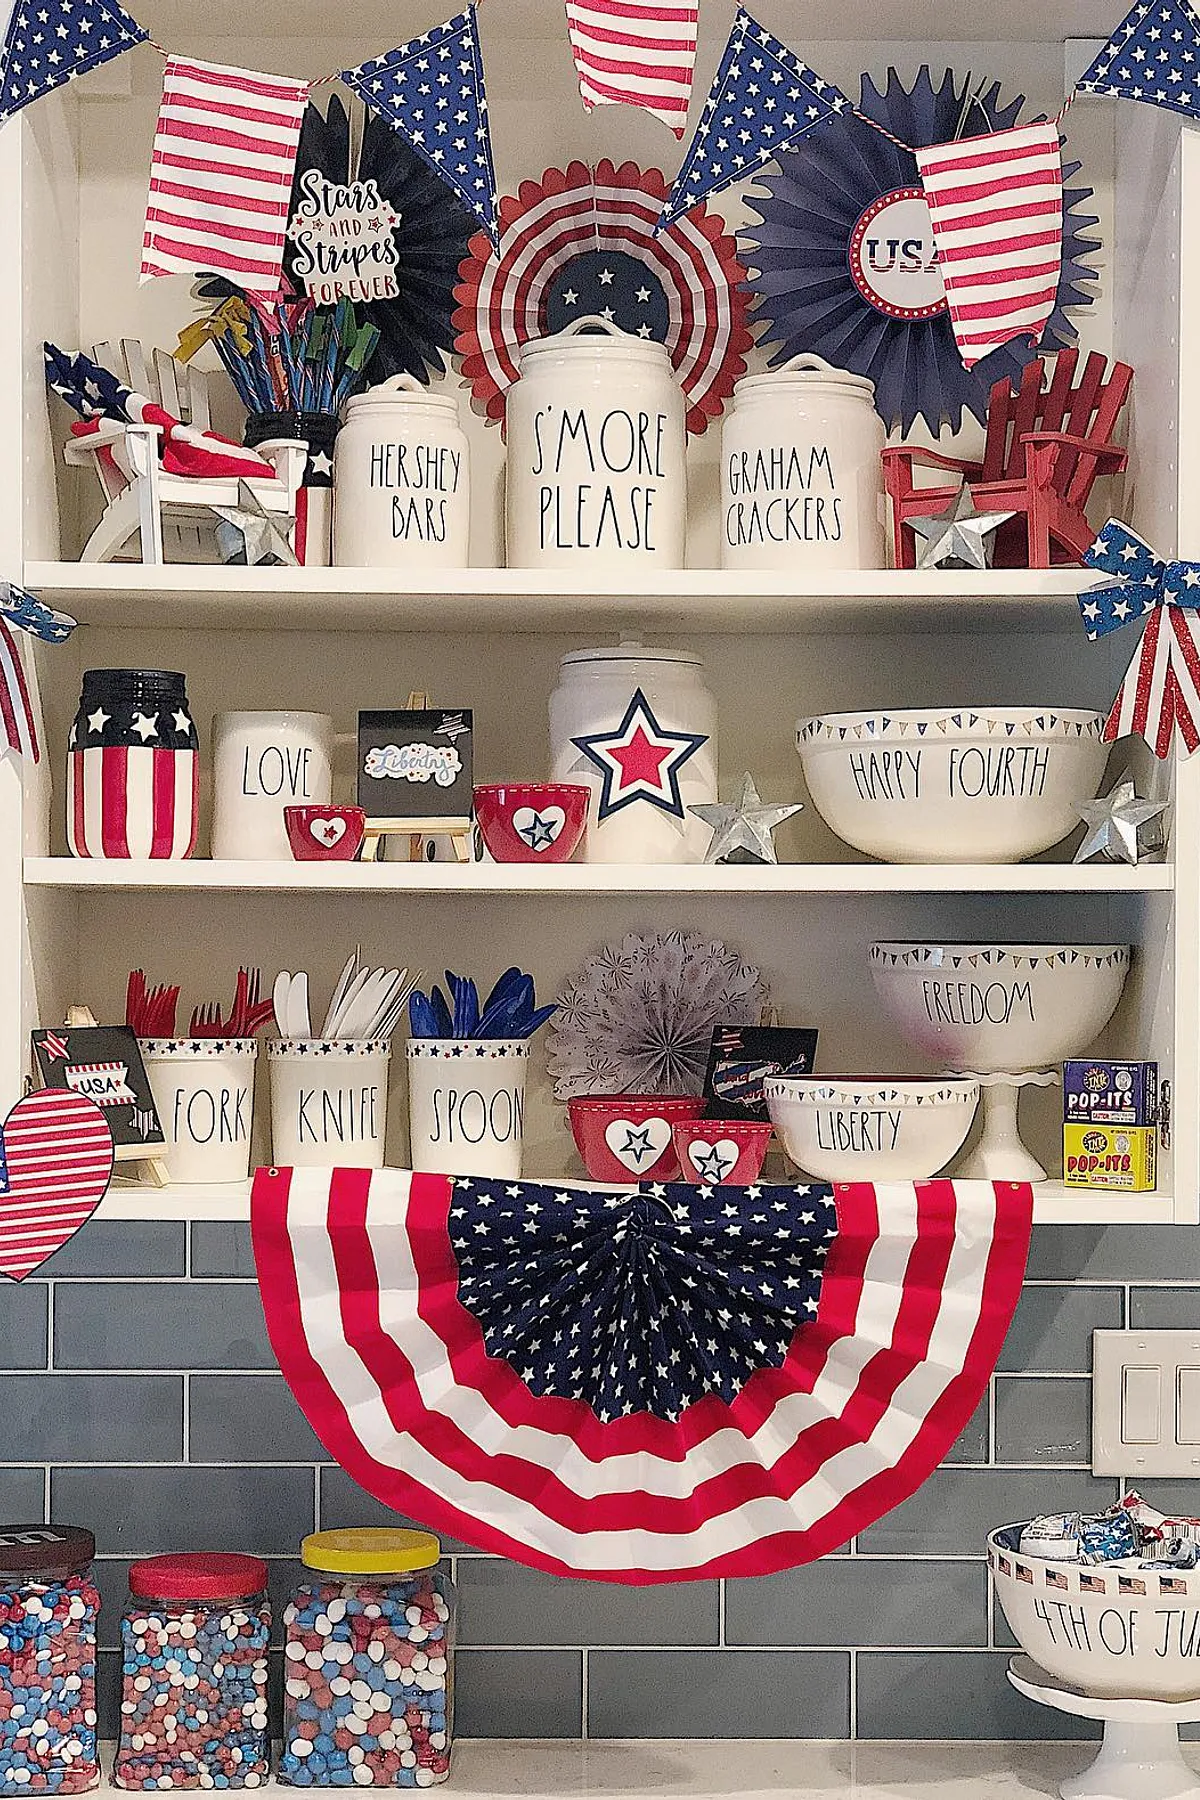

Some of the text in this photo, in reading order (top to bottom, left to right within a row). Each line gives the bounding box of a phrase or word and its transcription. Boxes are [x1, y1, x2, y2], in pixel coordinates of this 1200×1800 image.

[302, 173, 378, 218] Stars
[329, 218, 362, 238] AND
[296, 231, 396, 278] Stripes
[308, 275, 396, 303] FOREVER
[531, 407, 668, 478] S'MORE
[370, 443, 461, 494] HERSHEY
[729, 446, 835, 496] GRAHAM
[391, 496, 447, 543] BARS
[540, 484, 657, 551] PLEASE
[726, 497, 842, 547] CRACKERS
[242, 745, 313, 798] LOVE
[373, 749, 455, 781] Liberty
[850, 746, 1050, 800] HAPPY FOURTH
[922, 980, 1035, 1024] FREEDOM
[80, 1077, 117, 1094] USA
[1068, 1091, 1133, 1109] POP-ITS
[174, 1087, 247, 1143] FORK
[299, 1086, 378, 1143] KNIFE
[430, 1087, 524, 1143] SPOON
[816, 1110, 902, 1151] LIBERTY
[1067, 1154, 1131, 1172] POP-ITS
[1033, 1598, 1093, 1652] 4TH
[1099, 1609, 1139, 1657] OF
